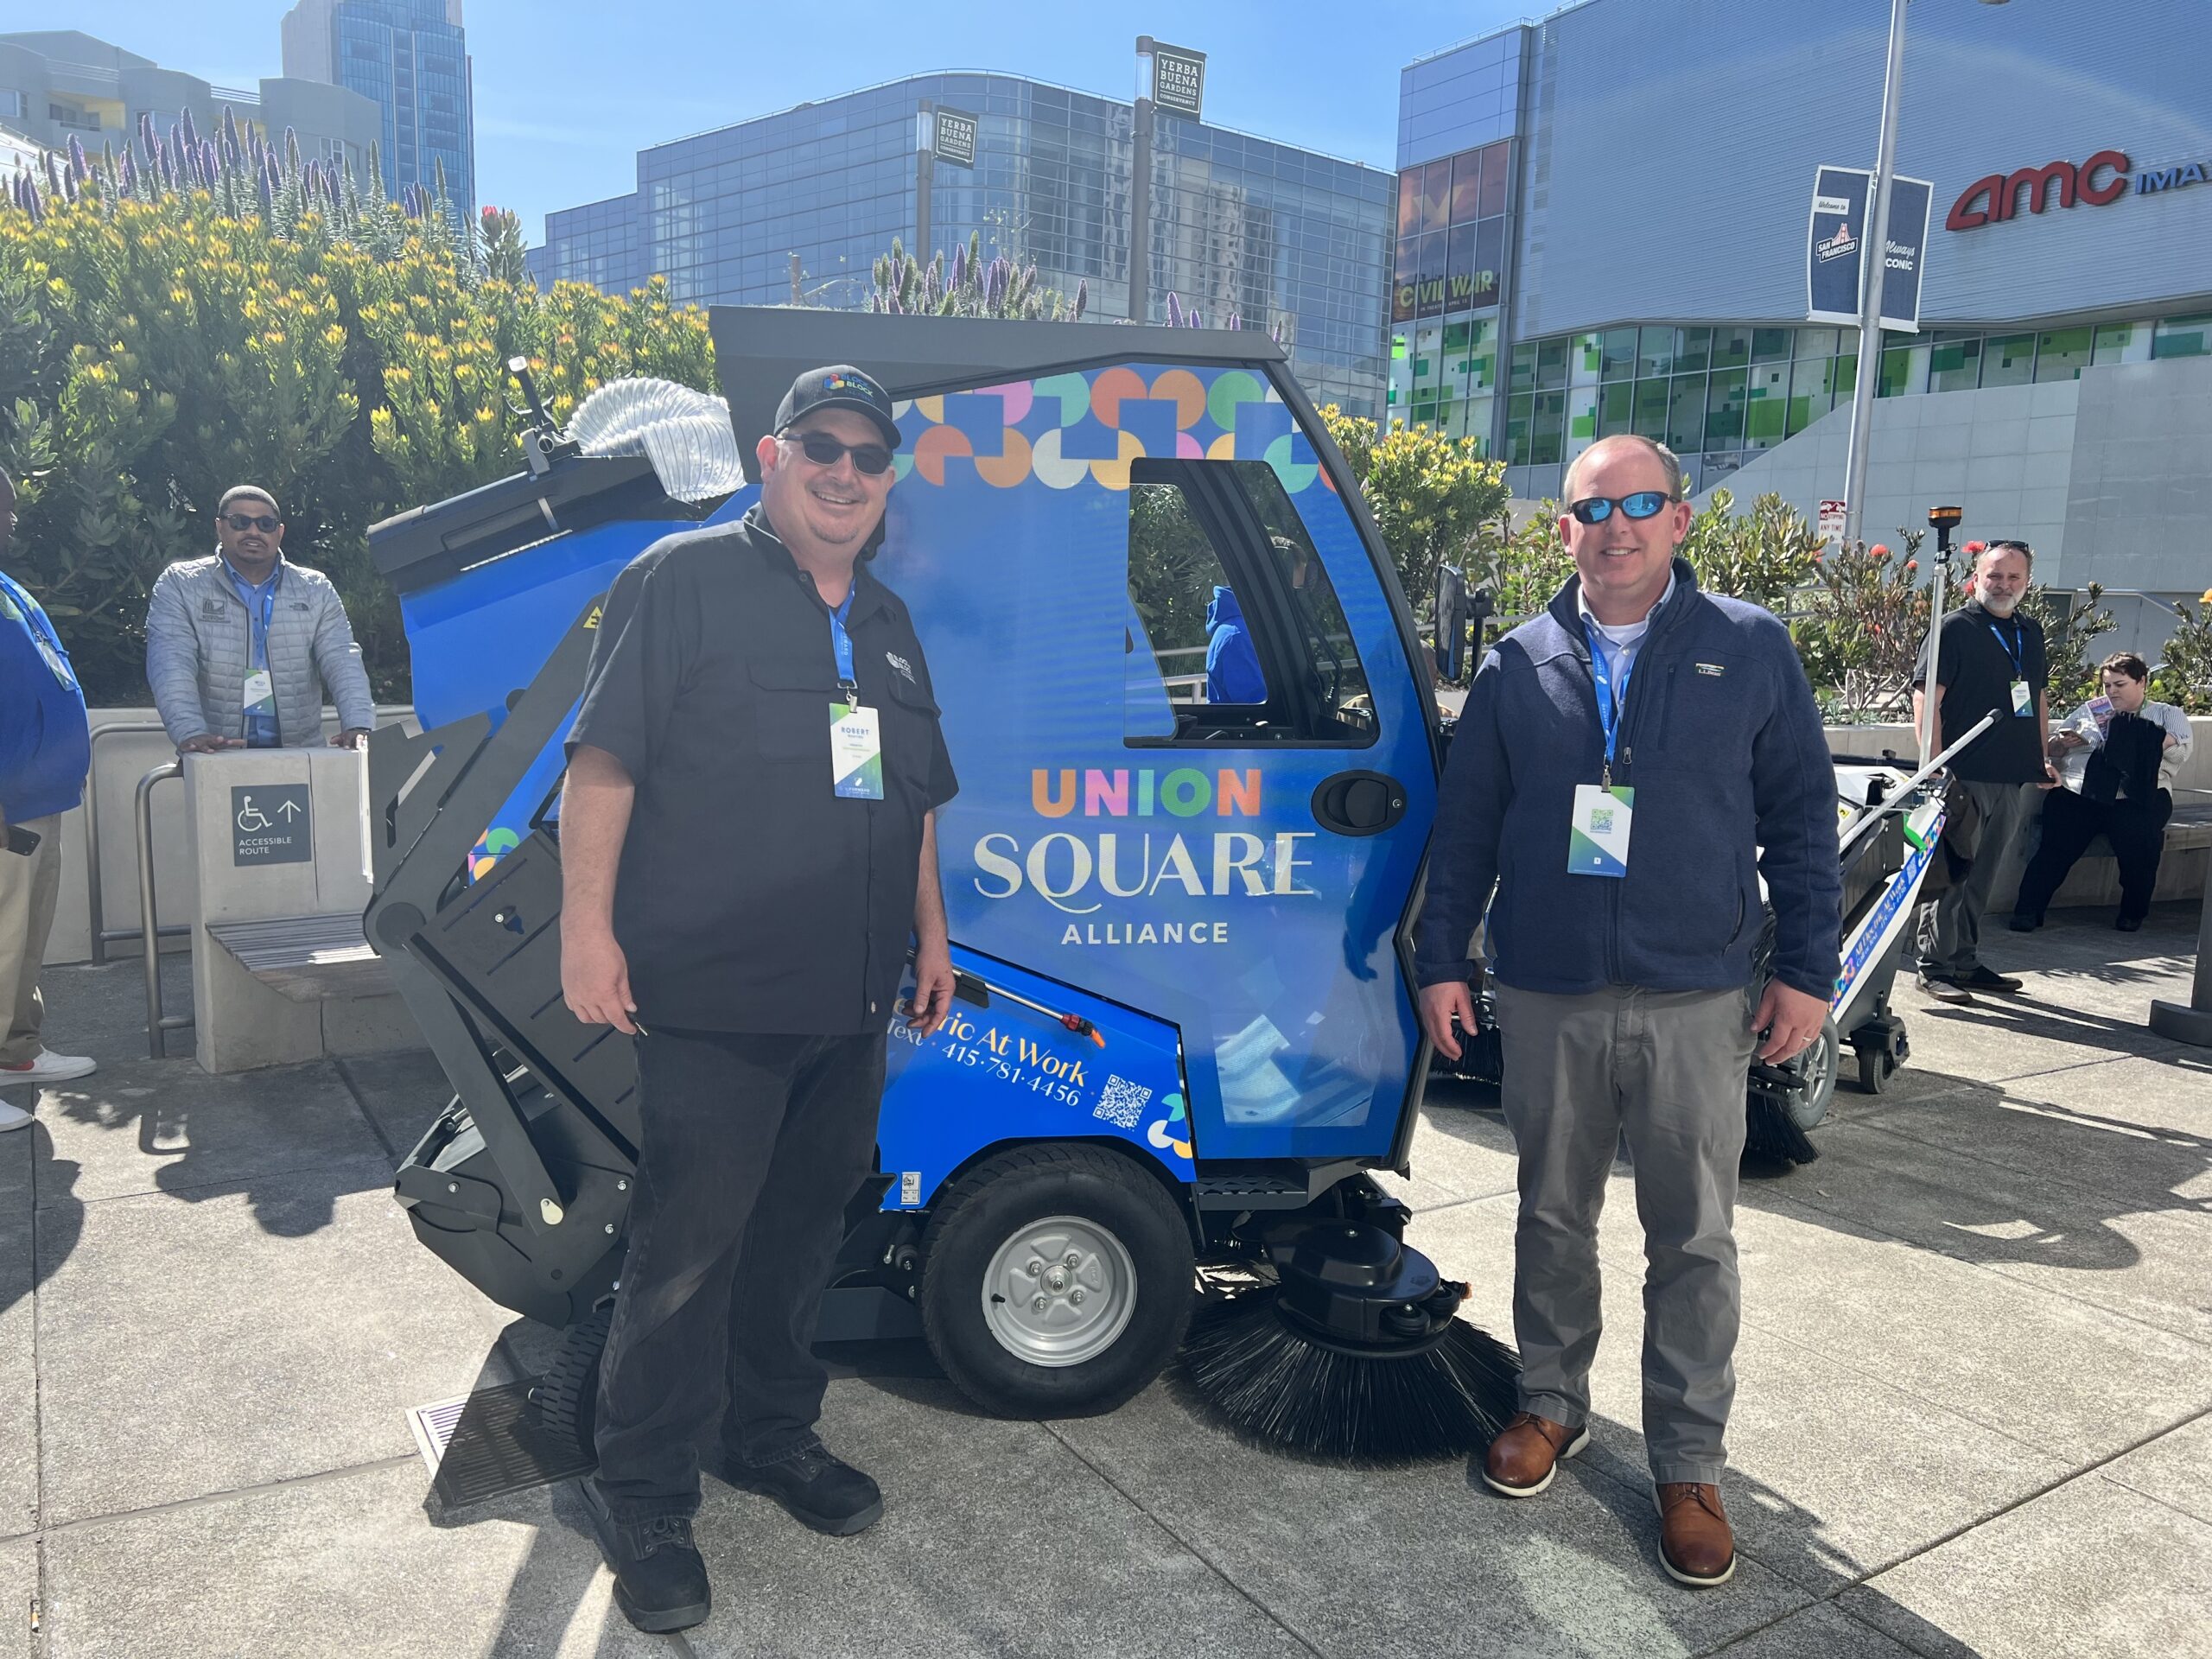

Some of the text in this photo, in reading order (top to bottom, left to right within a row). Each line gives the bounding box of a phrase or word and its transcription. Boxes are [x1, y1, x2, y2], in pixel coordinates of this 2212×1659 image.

[1161, 59, 1198, 77] YERBA
[1160, 70, 1198, 88] BUENA
[1160, 81, 1197, 96] GARDENS
[941, 118, 973, 133] YERBA
[940, 126, 972, 143] BUENA
[940, 136, 971, 149] GARDENS
[2135, 162, 2212, 194] IMA
[1819, 200, 1840, 209] Welcome
[1818, 242, 1831, 252] SAN
[1821, 241, 1855, 259] FRANCISCO
[1885, 257, 1914, 270] CONIC
[1400, 270, 1494, 308] CIVIL WAR
[847, 381, 874, 397] BLOCK
[841, 726, 869, 735] ROBERT
[1031, 767, 1262, 818] UNION
[238, 836, 292, 847] ACCESSIBLE
[239, 847, 270, 855] ROUTE
[974, 832, 1316, 914] SQUARE
[1060, 922, 1229, 944] ALLIANCE
[976, 1027, 1013, 1057] At
[1018, 1037, 1090, 1088] Work
